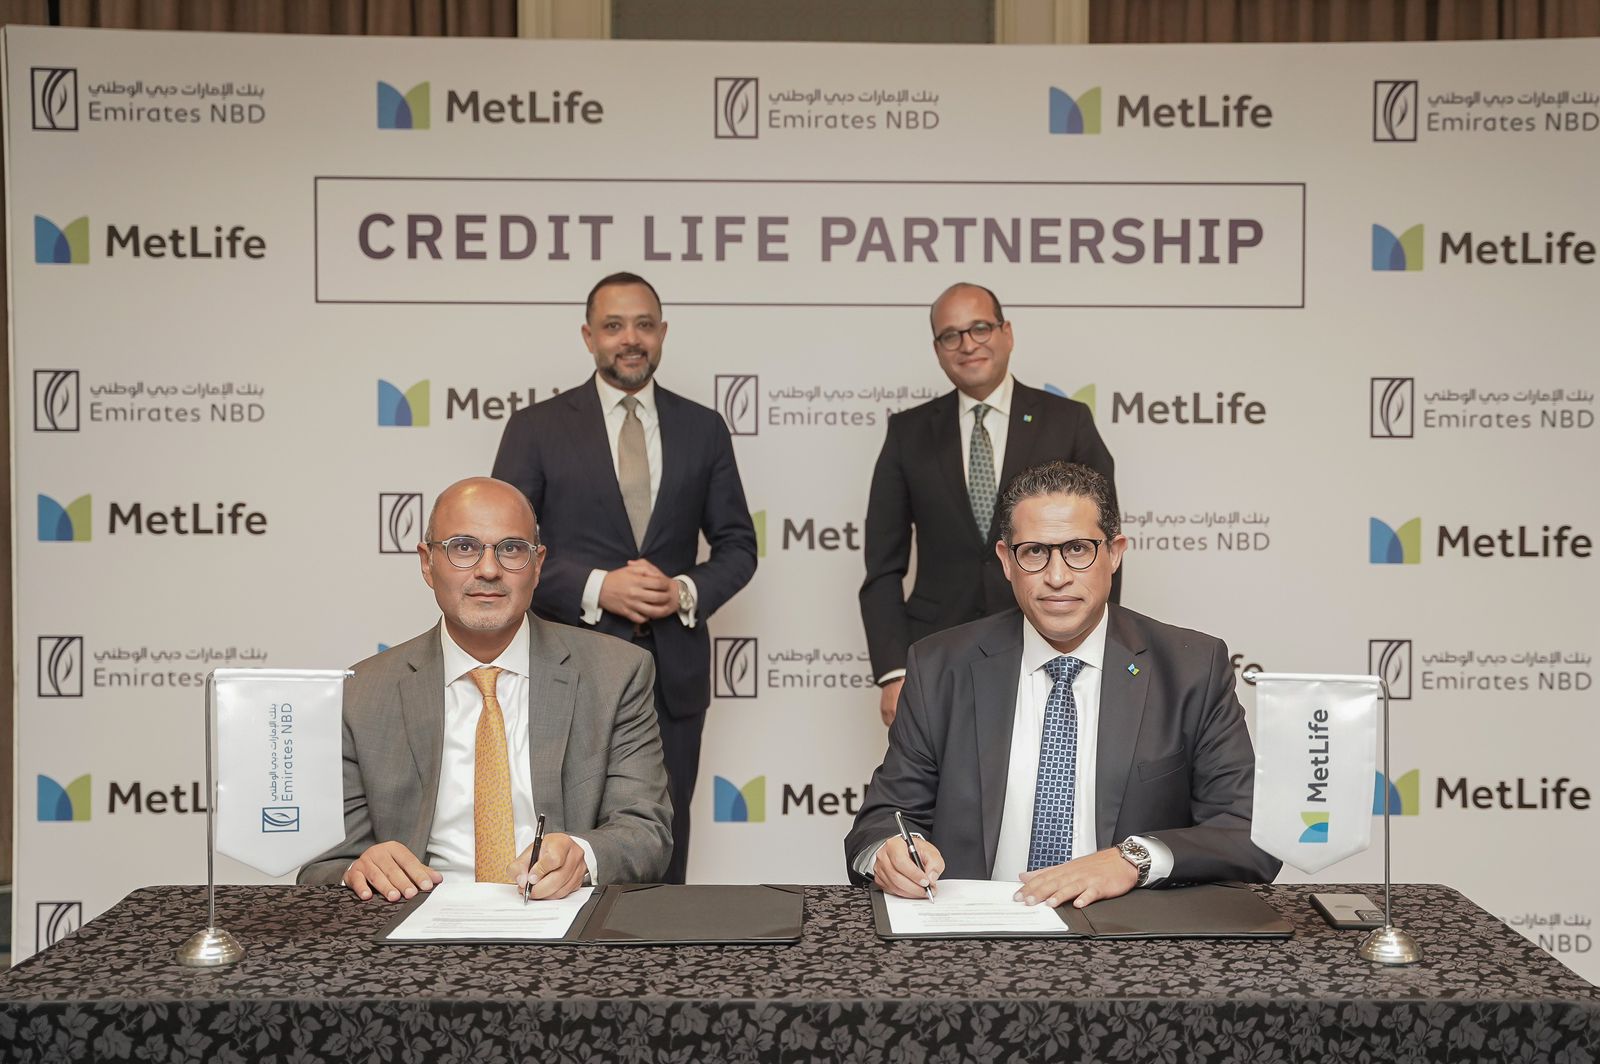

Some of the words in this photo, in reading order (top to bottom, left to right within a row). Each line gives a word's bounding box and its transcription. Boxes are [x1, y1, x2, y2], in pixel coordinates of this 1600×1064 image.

[89, 101, 201, 123] Emirates
[210, 103, 266, 124] NBD
[446, 90, 604, 125] MetLife
[768, 110, 876, 129] Emirates
[886, 111, 940, 130] NBD
[1117, 94, 1273, 129] MetLife
[1426, 112, 1536, 132] Emirates
[1545, 112, 1600, 132] NBD
[106, 224, 267, 259] MetLife
[358, 212, 614, 261] CREDIT
[643, 215, 790, 262] LIFE
[821, 216, 1264, 265] PARTNERSHIP
[1439, 231, 1597, 265] MetLife
[90, 402, 201, 422] Emirates
[210, 403, 265, 422] NBD
[768, 407, 876, 426] Emirates
[1111, 391, 1267, 425] MetLife
[1423, 410, 1532, 429] Emirates
[1540, 410, 1595, 429] NBD
[108, 502, 268, 536] MetLife
[1127, 532, 1208, 551] irates
[1217, 532, 1270, 551] NBD
[1437, 525, 1593, 559] MetLife
[94, 667, 204, 687] Emirates
[767, 669, 875, 688] Emirates
[1422, 671, 1529, 691] Emirates
[1538, 672, 1592, 691] NBD
[280, 702, 293, 734] NBD
[281, 739, 293, 801] Emirates
[1306, 709, 1330, 802] MetLife
[1435, 777, 1592, 811] MetLife
[1538, 934, 1593, 953] NBD
